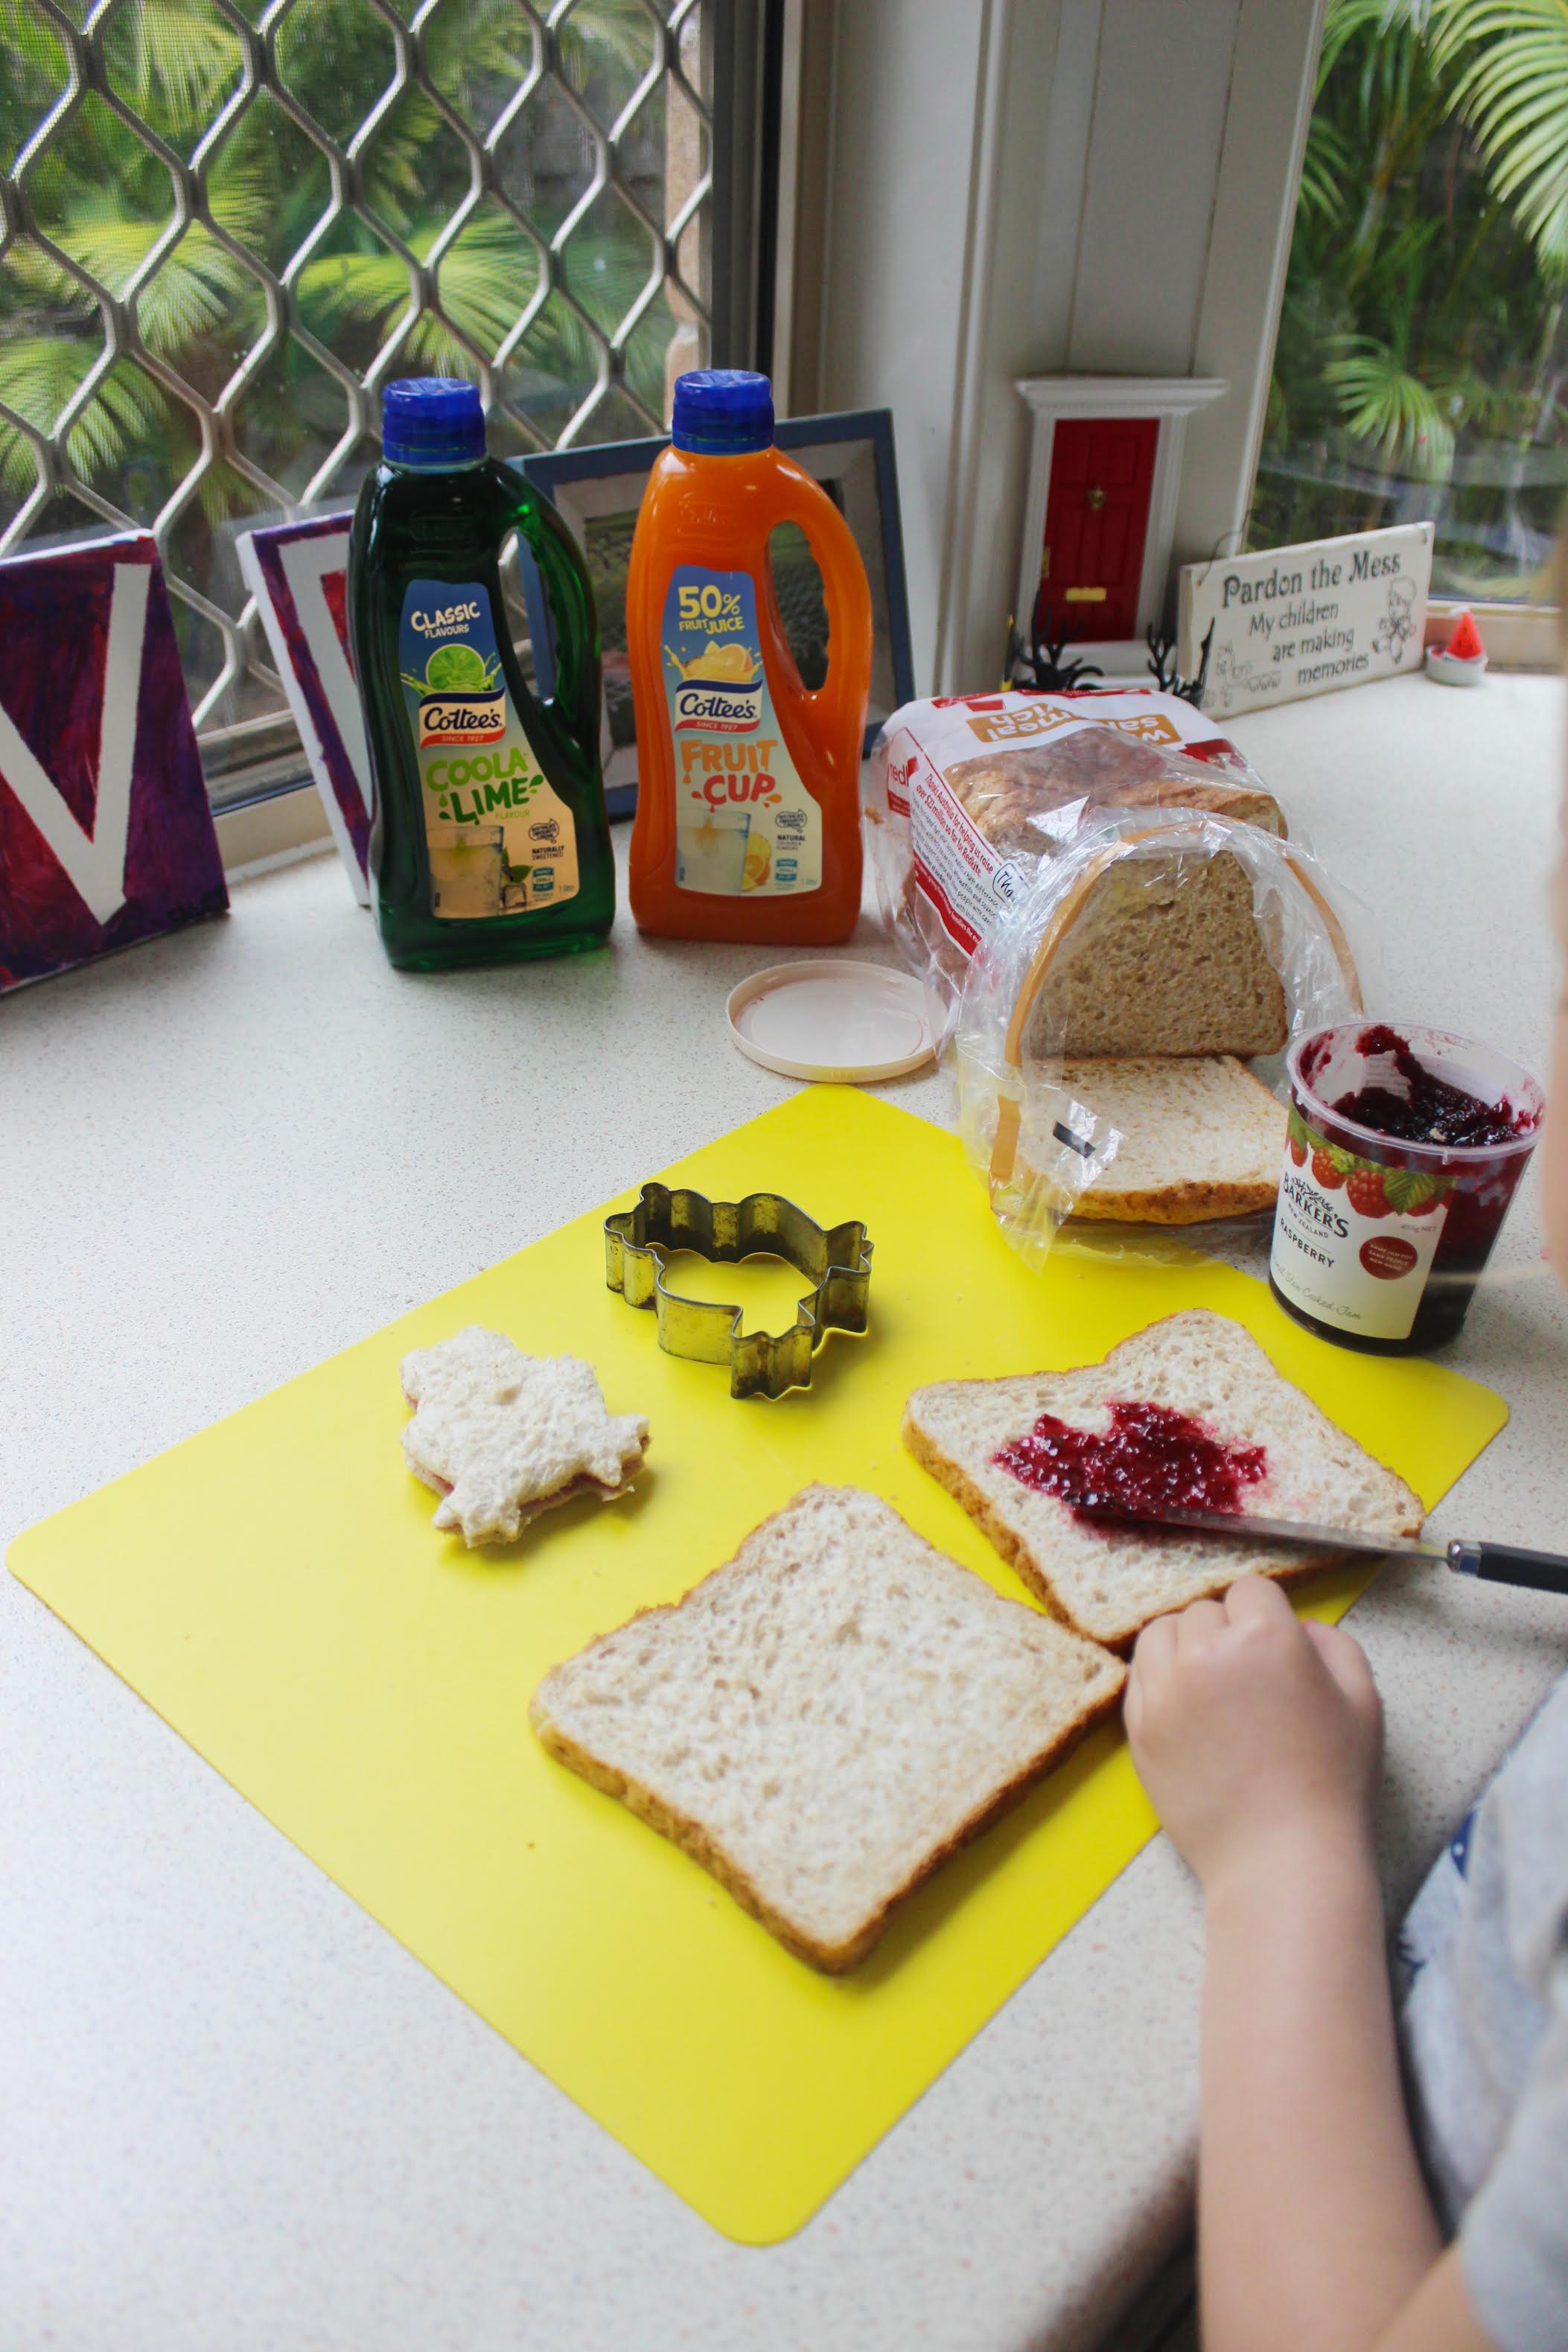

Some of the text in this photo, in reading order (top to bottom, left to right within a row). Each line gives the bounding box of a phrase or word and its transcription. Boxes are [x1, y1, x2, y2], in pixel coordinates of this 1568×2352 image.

[1223, 549, 1400, 608] Pardon the Mess
[411, 601, 481, 632] CLASSIC
[678, 584, 742, 619] 50%
[424, 624, 471, 640] FLAVOURS
[679, 616, 745, 634] FRUIT JUICE
[1249, 601, 1339, 641] My children
[1273, 627, 1355, 662] are making
[1298, 652, 1369, 686] memories
[424, 707, 501, 730] Cottee's
[680, 692, 756, 719] Cottee's
[442, 735, 485, 743] SINCE 1927
[696, 721, 738, 731] SINCE 1927
[425, 748, 529, 792] COOLA
[681, 739, 778, 774] FRUIT
[450, 777, 530, 824] LIME
[703, 774, 777, 806] CUP
[915, 785, 927, 798] over
[962, 847, 980, 878] Redkite.
[924, 773, 940, 795] Thanks
[936, 791, 954, 818] Australia
[958, 822, 975, 852] helping
[974, 847, 981, 858] us
[980, 855, 993, 874] raise
[532, 845, 565, 855] NATURALLY
[1283, 1171, 1349, 1237] BARKER'S
[1281, 1217, 1334, 1267] RASPBERRY
[1298, 1219, 1329, 1238] ZEALAND
